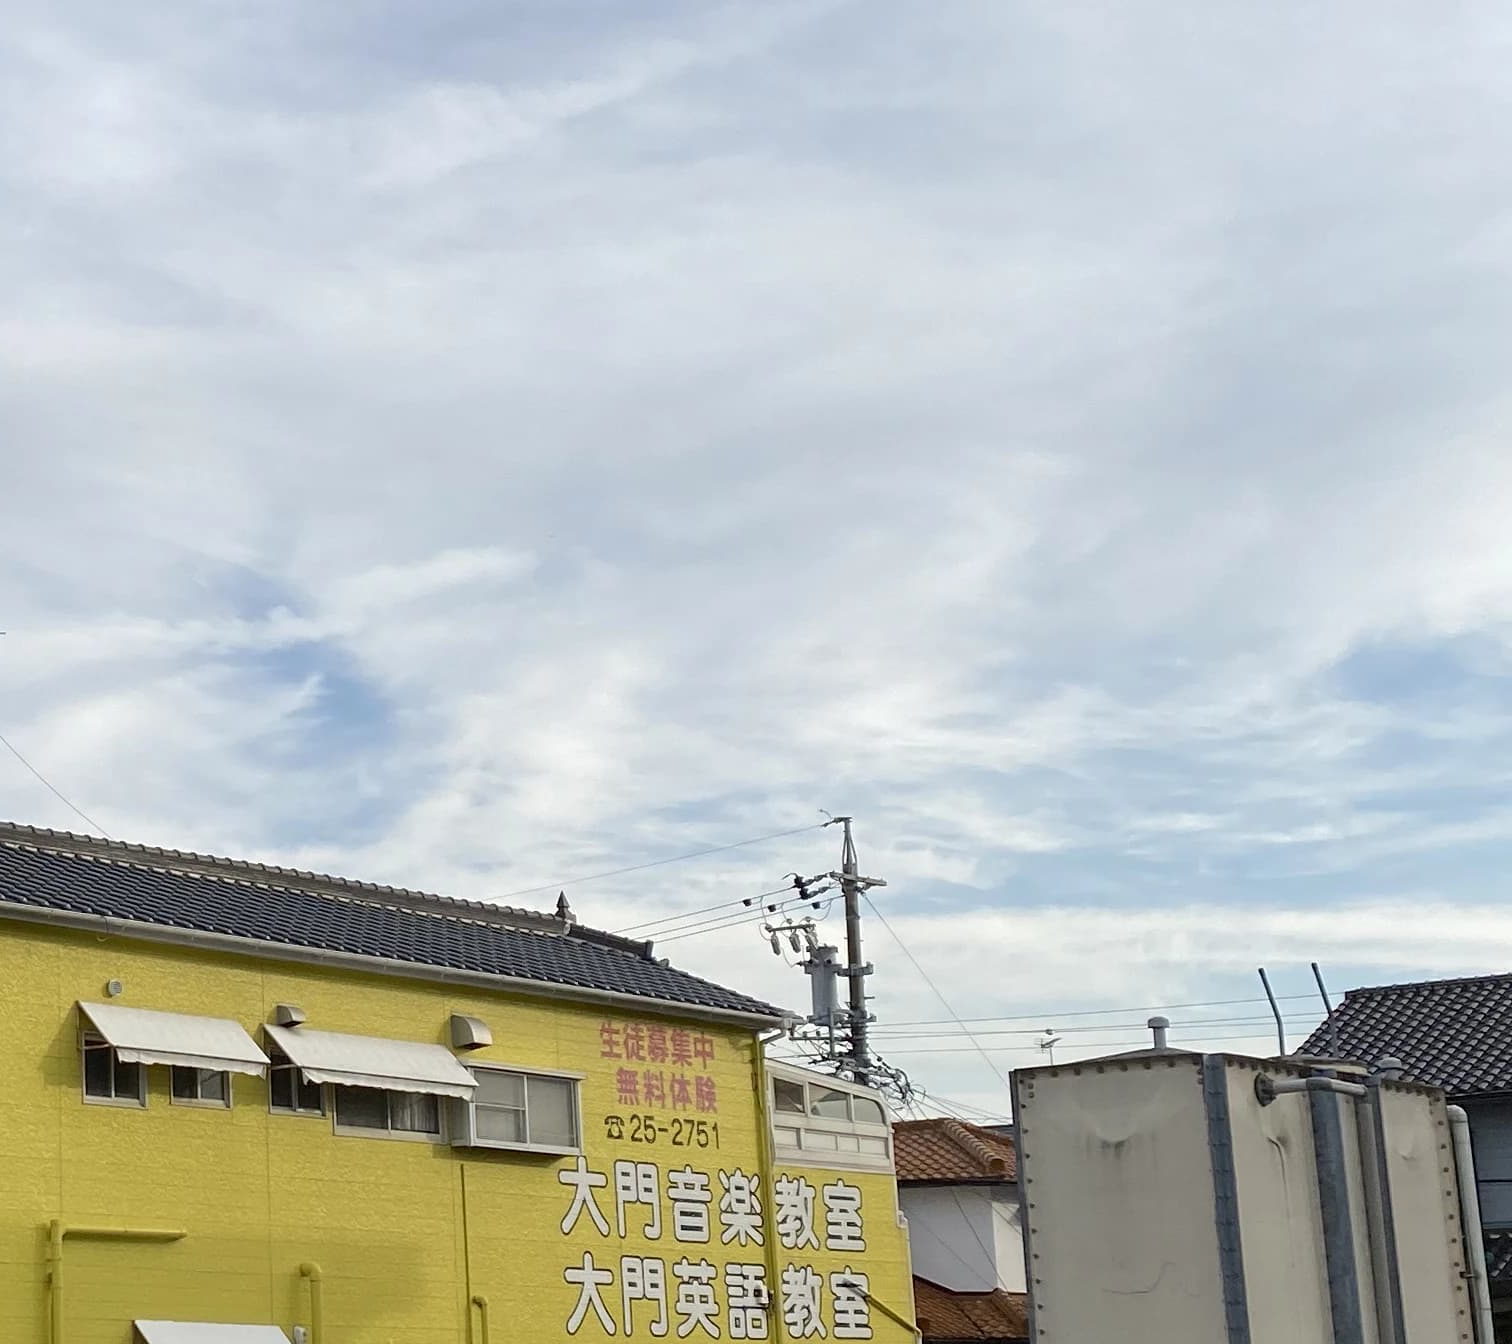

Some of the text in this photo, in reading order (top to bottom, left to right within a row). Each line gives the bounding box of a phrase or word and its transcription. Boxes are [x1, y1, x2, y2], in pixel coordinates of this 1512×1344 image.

[599, 1020, 715, 1069] 生徒募集中
[615, 1066, 718, 1114] 無料体験
[629, 1113, 720, 1149] 25-2751
[558, 1155, 867, 1253] 大門音楽教室
[563, 1251, 874, 1341] 大門英語教室
